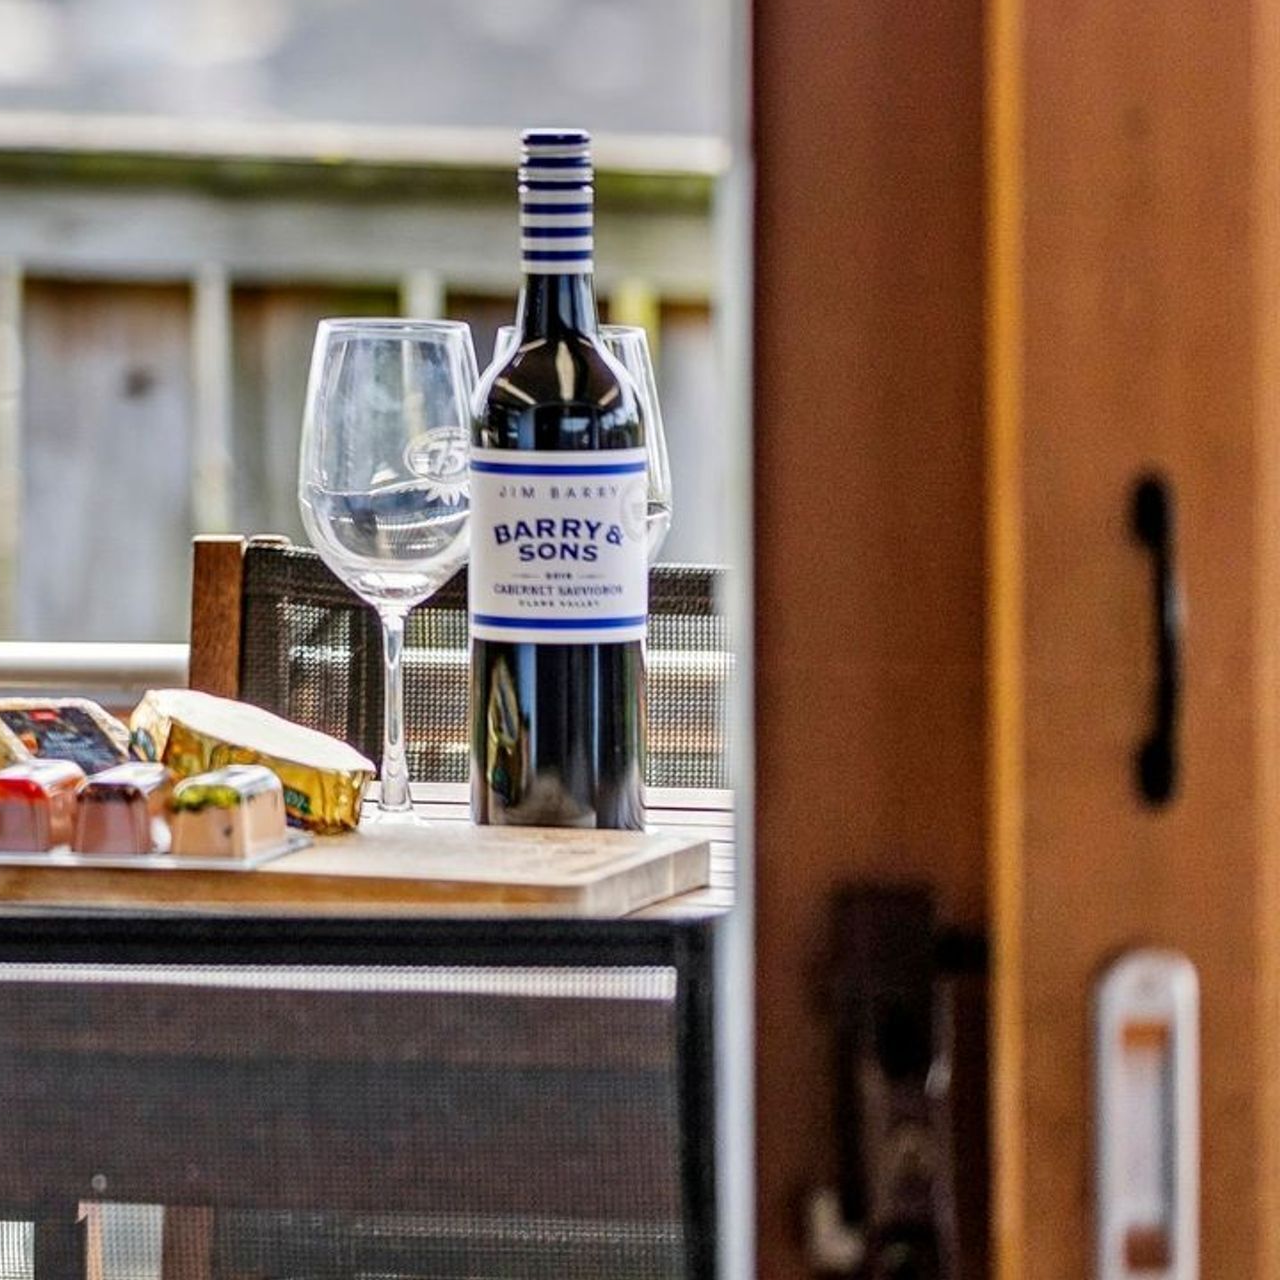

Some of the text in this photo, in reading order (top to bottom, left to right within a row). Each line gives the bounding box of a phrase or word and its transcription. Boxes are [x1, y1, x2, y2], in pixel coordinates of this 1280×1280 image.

[499, 486, 617, 499] JIM BARRY
[519, 542, 598, 562] SONS
[493, 584, 554, 596] CABERNET
